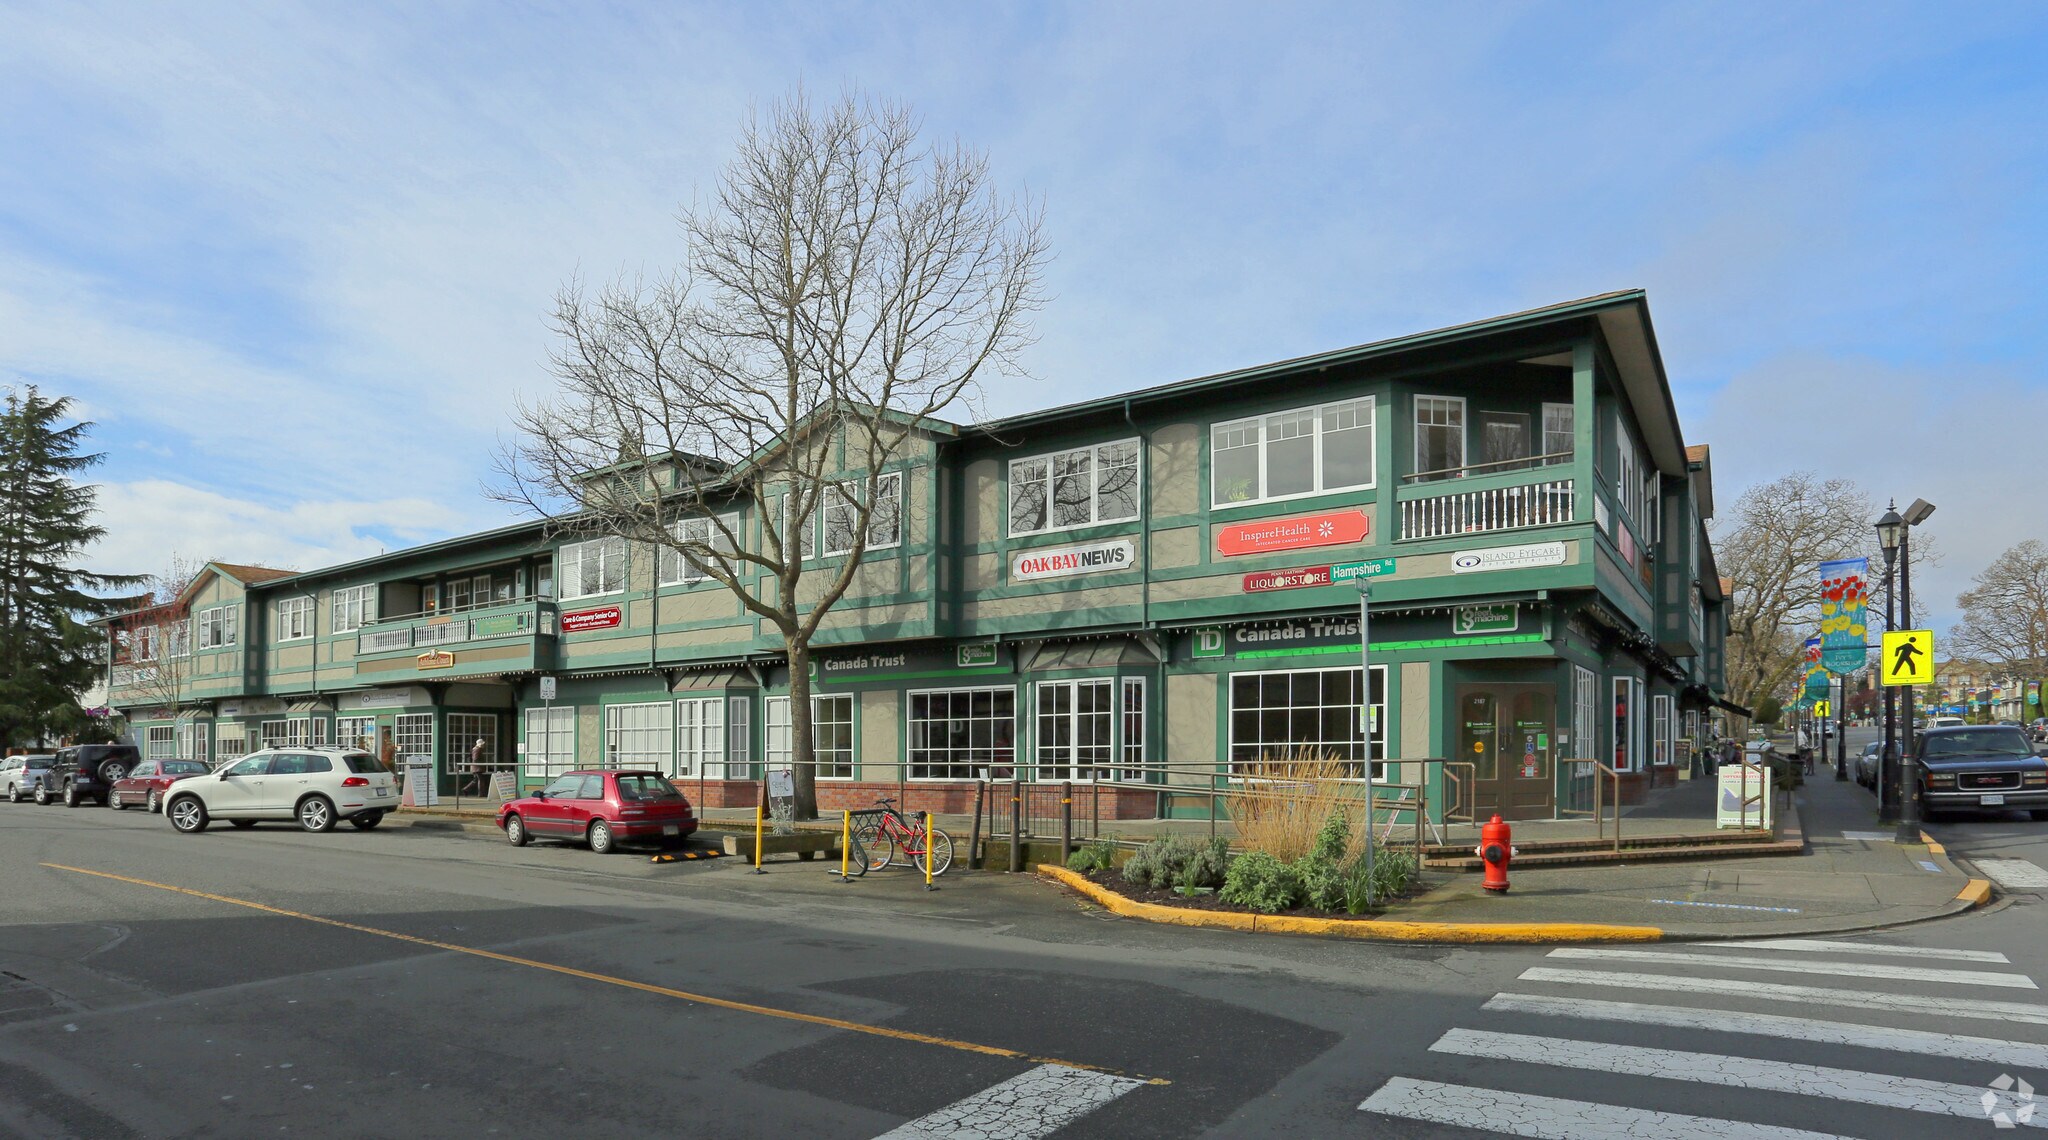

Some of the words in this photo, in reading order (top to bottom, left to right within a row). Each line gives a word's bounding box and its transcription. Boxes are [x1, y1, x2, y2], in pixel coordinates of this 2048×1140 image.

[1240, 523, 1311, 543] InspireHealth
[1021, 556, 1051, 574] OAK
[1052, 552, 1081, 570] BAY
[1081, 547, 1125, 566] NEWS
[1482, 551, 1516, 562] ISLAND
[1519, 546, 1561, 556] EYECARE
[1333, 562, 1382, 579] Hampshire
[1197, 630, 1222, 651] TD
[1235, 623, 1306, 643] Canada
[825, 658, 868, 671] Canada
[870, 653, 905, 668] Trust
